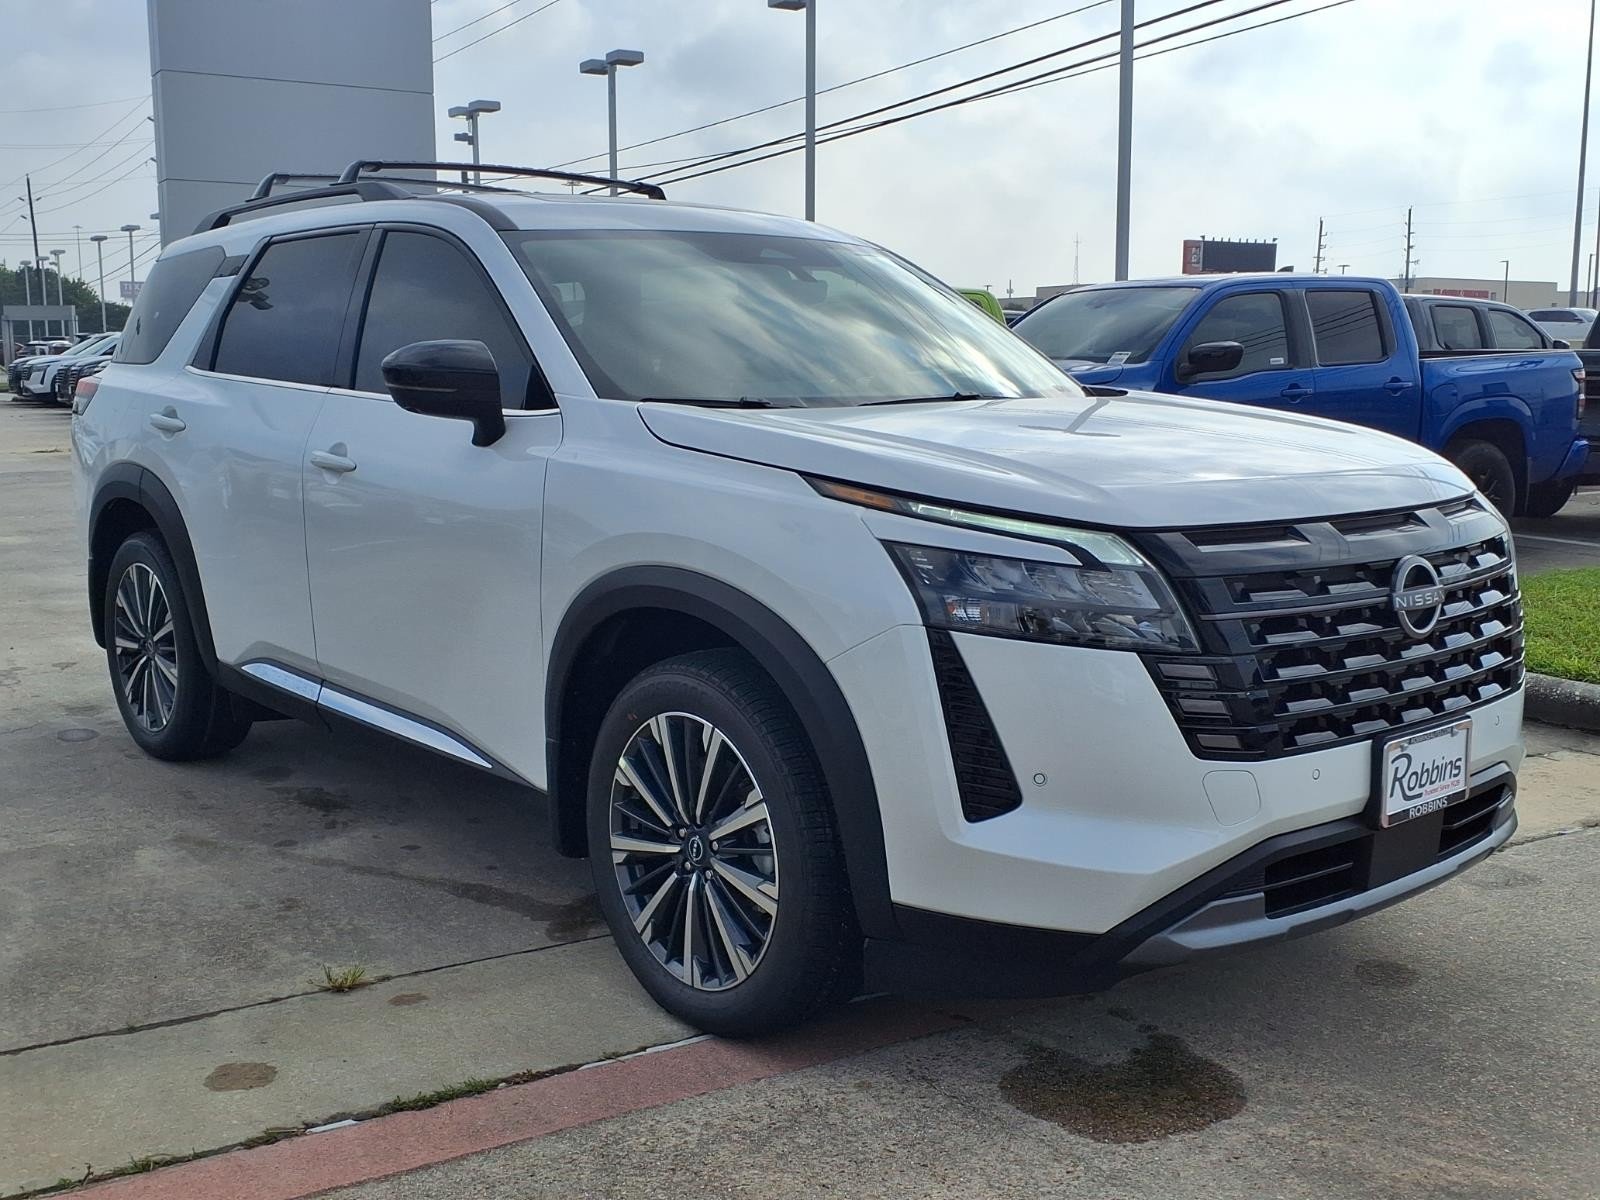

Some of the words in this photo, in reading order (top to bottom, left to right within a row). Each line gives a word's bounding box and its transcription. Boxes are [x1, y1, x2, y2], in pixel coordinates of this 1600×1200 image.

[1395, 590, 1445, 608] NISSAN
[1389, 753, 1462, 801] Robbins
[1409, 796, 1448, 819] ROBBINS
